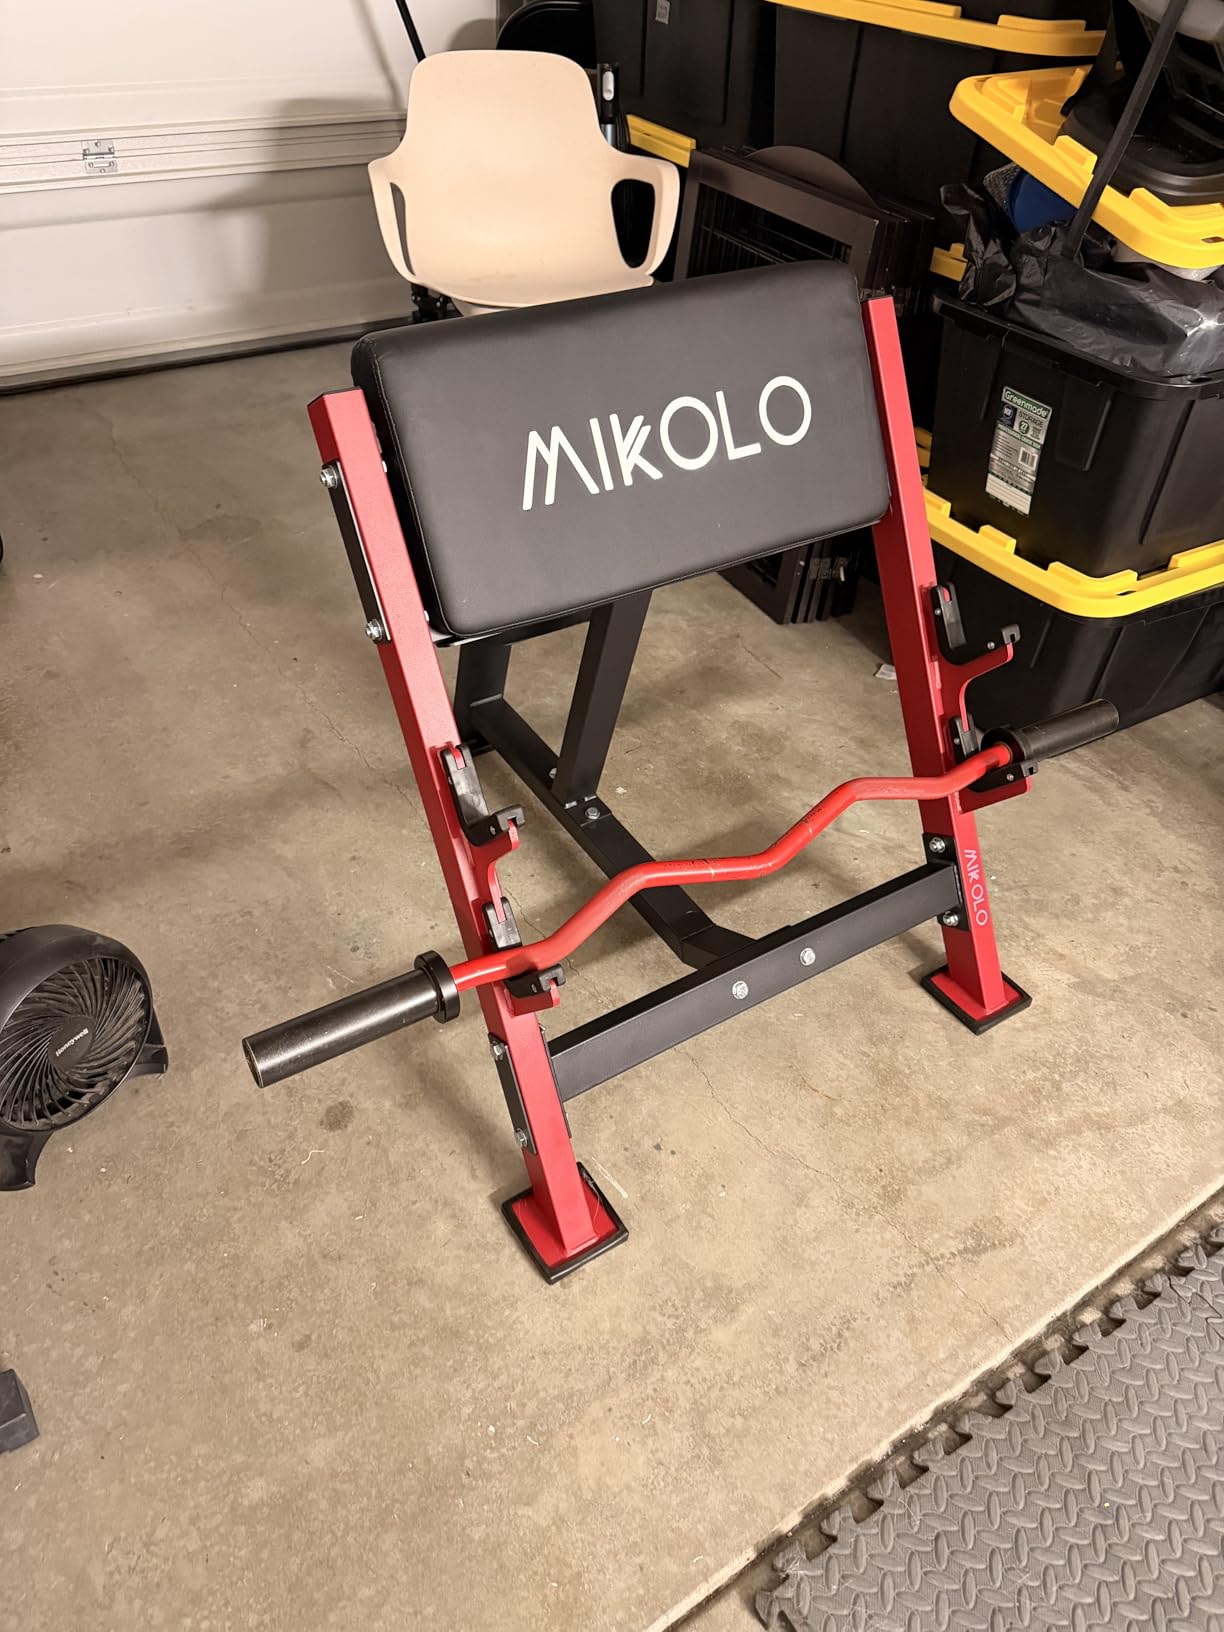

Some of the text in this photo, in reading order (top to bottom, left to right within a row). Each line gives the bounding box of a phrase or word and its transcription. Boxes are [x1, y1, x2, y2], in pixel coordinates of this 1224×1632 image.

[1005, 390, 1047, 418] Greenmade
[522, 375, 812, 510] MIKOLO
[963, 849, 988, 926] MIKOLO
[55, 1027, 89, 1057] Honeywell
